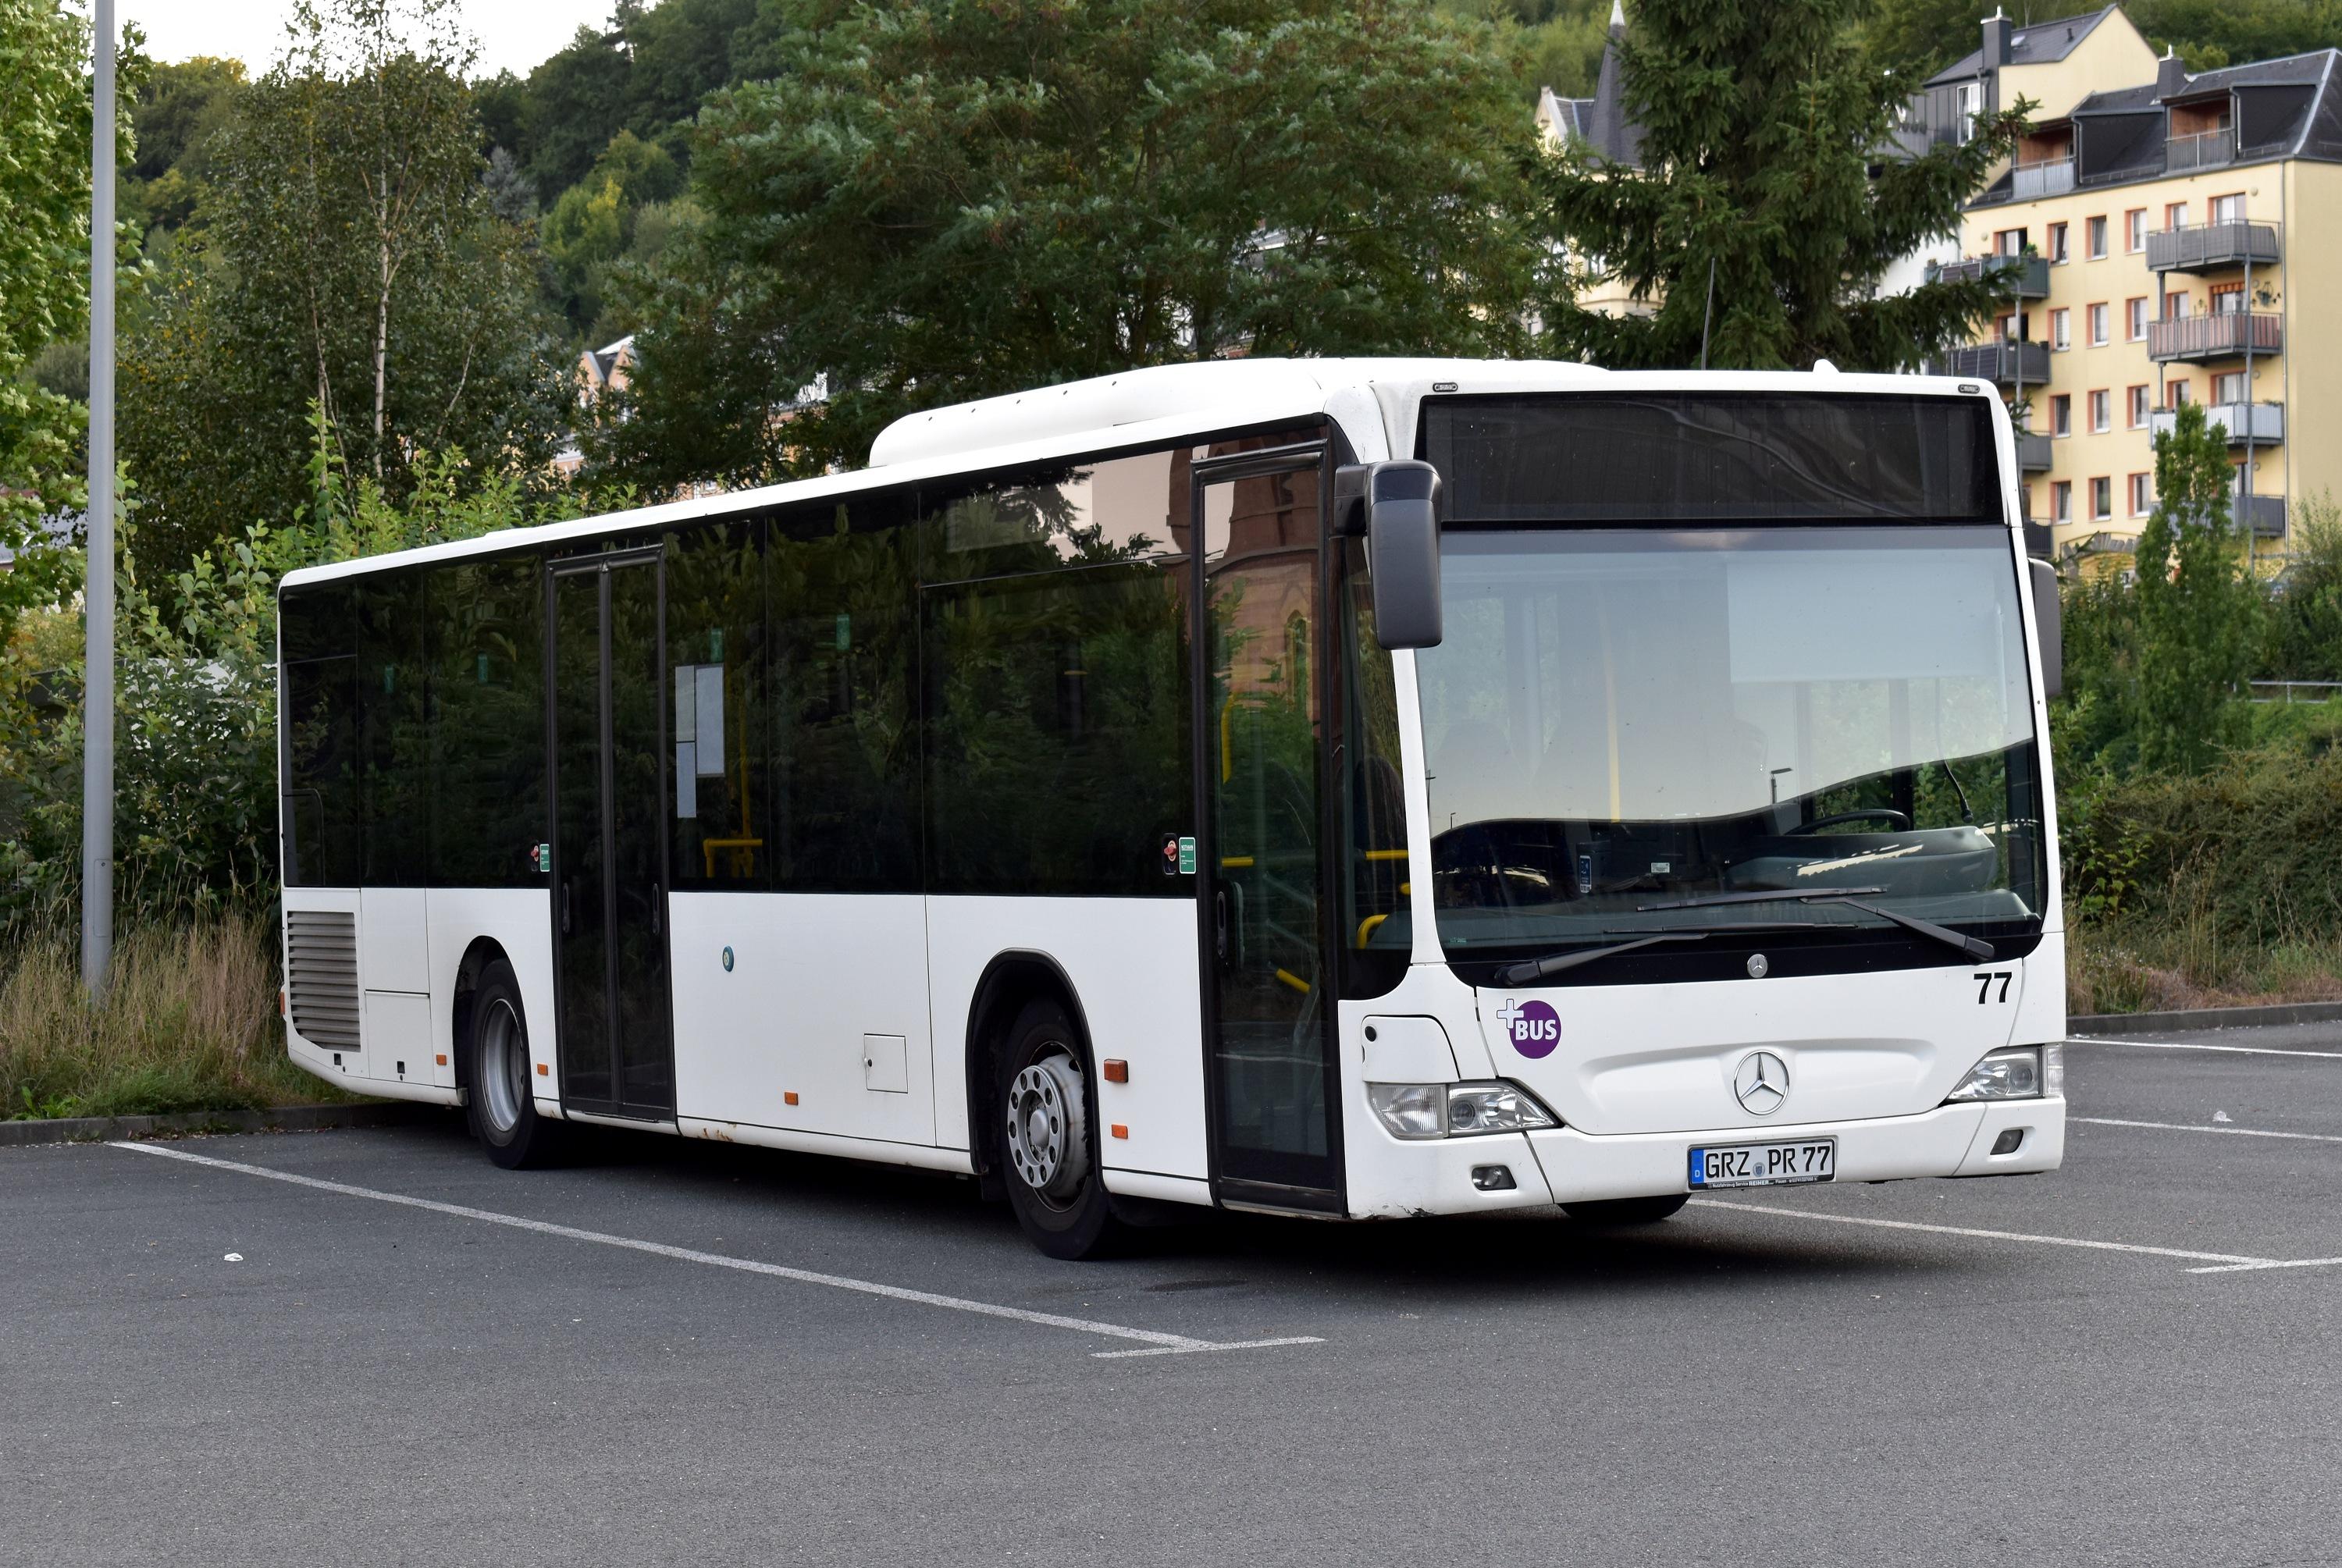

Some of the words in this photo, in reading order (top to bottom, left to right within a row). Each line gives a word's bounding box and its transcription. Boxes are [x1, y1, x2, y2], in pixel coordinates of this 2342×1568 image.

[1974, 972, 2013, 1004] 77
[1515, 1019, 1557, 1040] BUS
[1706, 1151, 1750, 1178] GRZ
[1767, 1148, 1796, 1174] PR
[1803, 1146, 1831, 1172] 77
